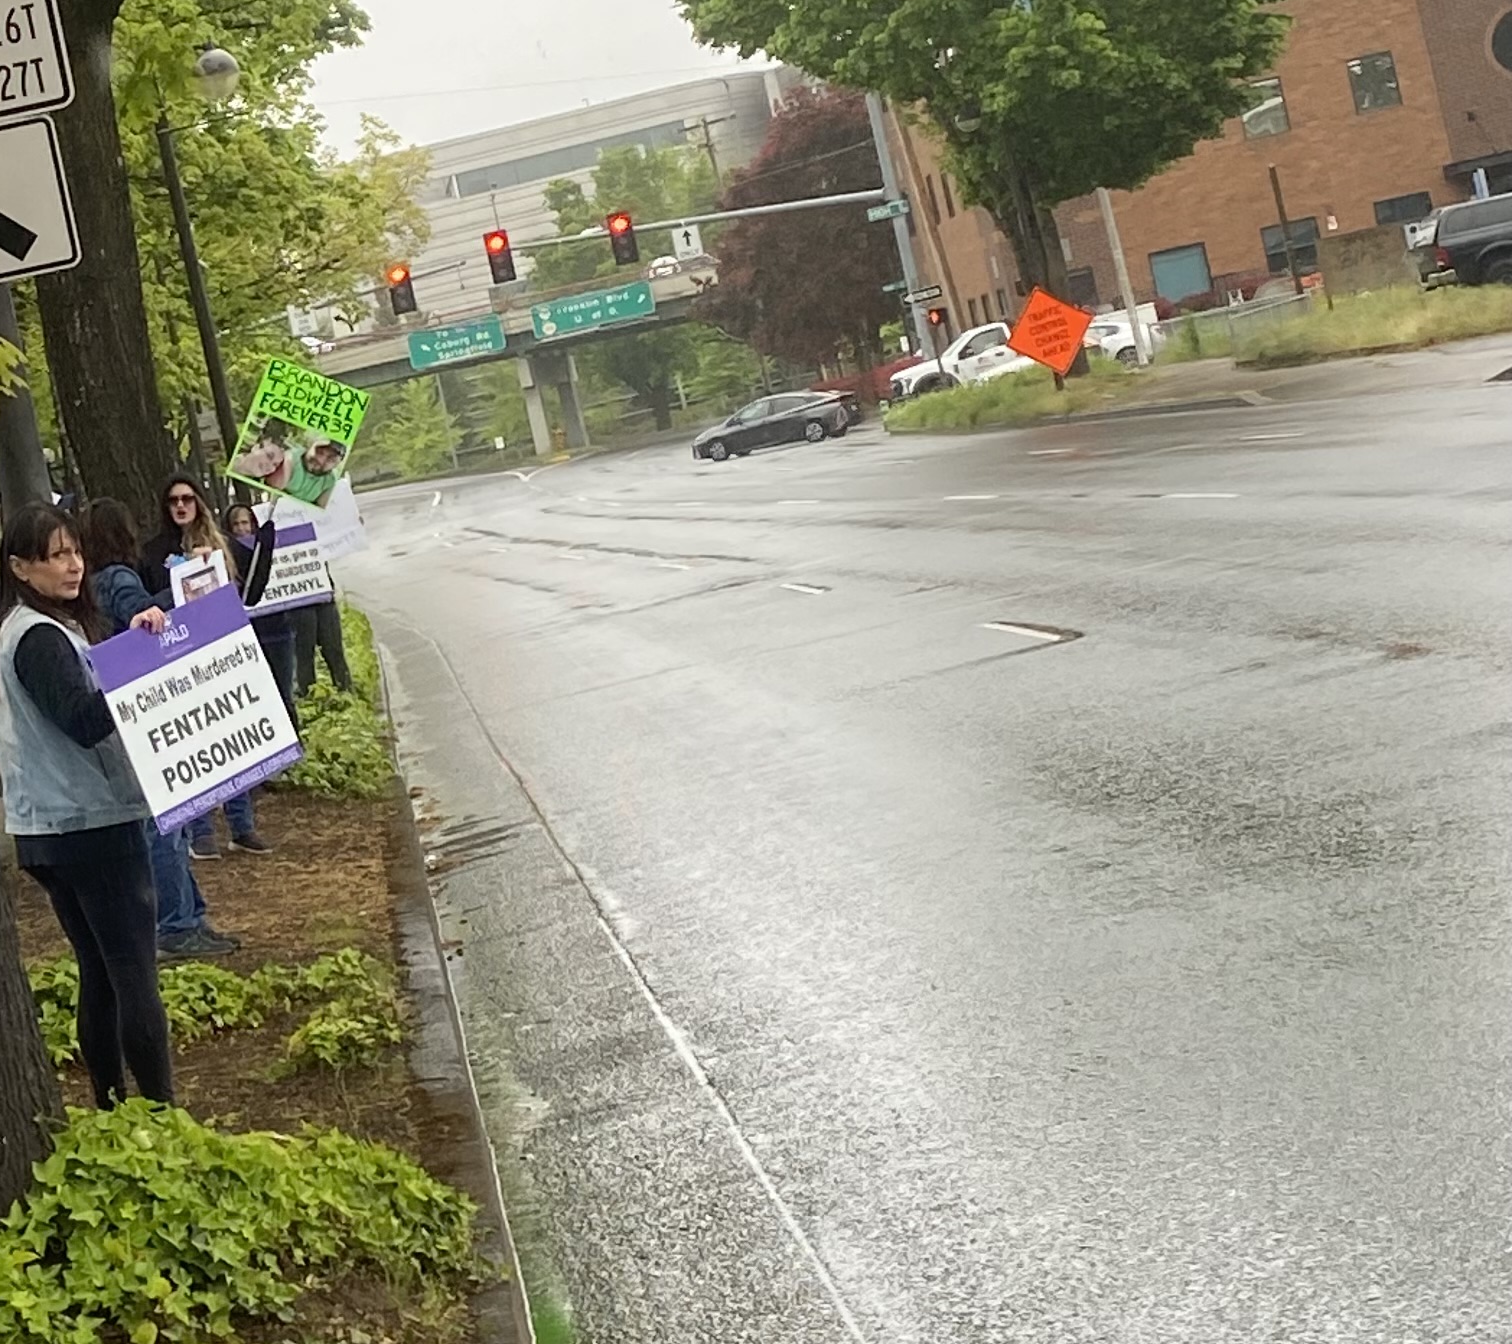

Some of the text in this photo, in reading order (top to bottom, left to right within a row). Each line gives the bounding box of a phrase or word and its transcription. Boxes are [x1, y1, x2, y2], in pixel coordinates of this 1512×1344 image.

[268, 360, 369, 411] BRANDON
[268, 377, 353, 423] TIDWELL
[260, 392, 353, 440] FOREVER 39
[264, 578, 325, 600] ENTANYL
[116, 700, 138, 724] My
[136, 683, 168, 713] Child
[164, 676, 193, 698] Was
[190, 645, 244, 686] Murdered
[241, 641, 259, 663] by
[147, 682, 260, 753] FENTANYL
[161, 717, 275, 792] POISONING
